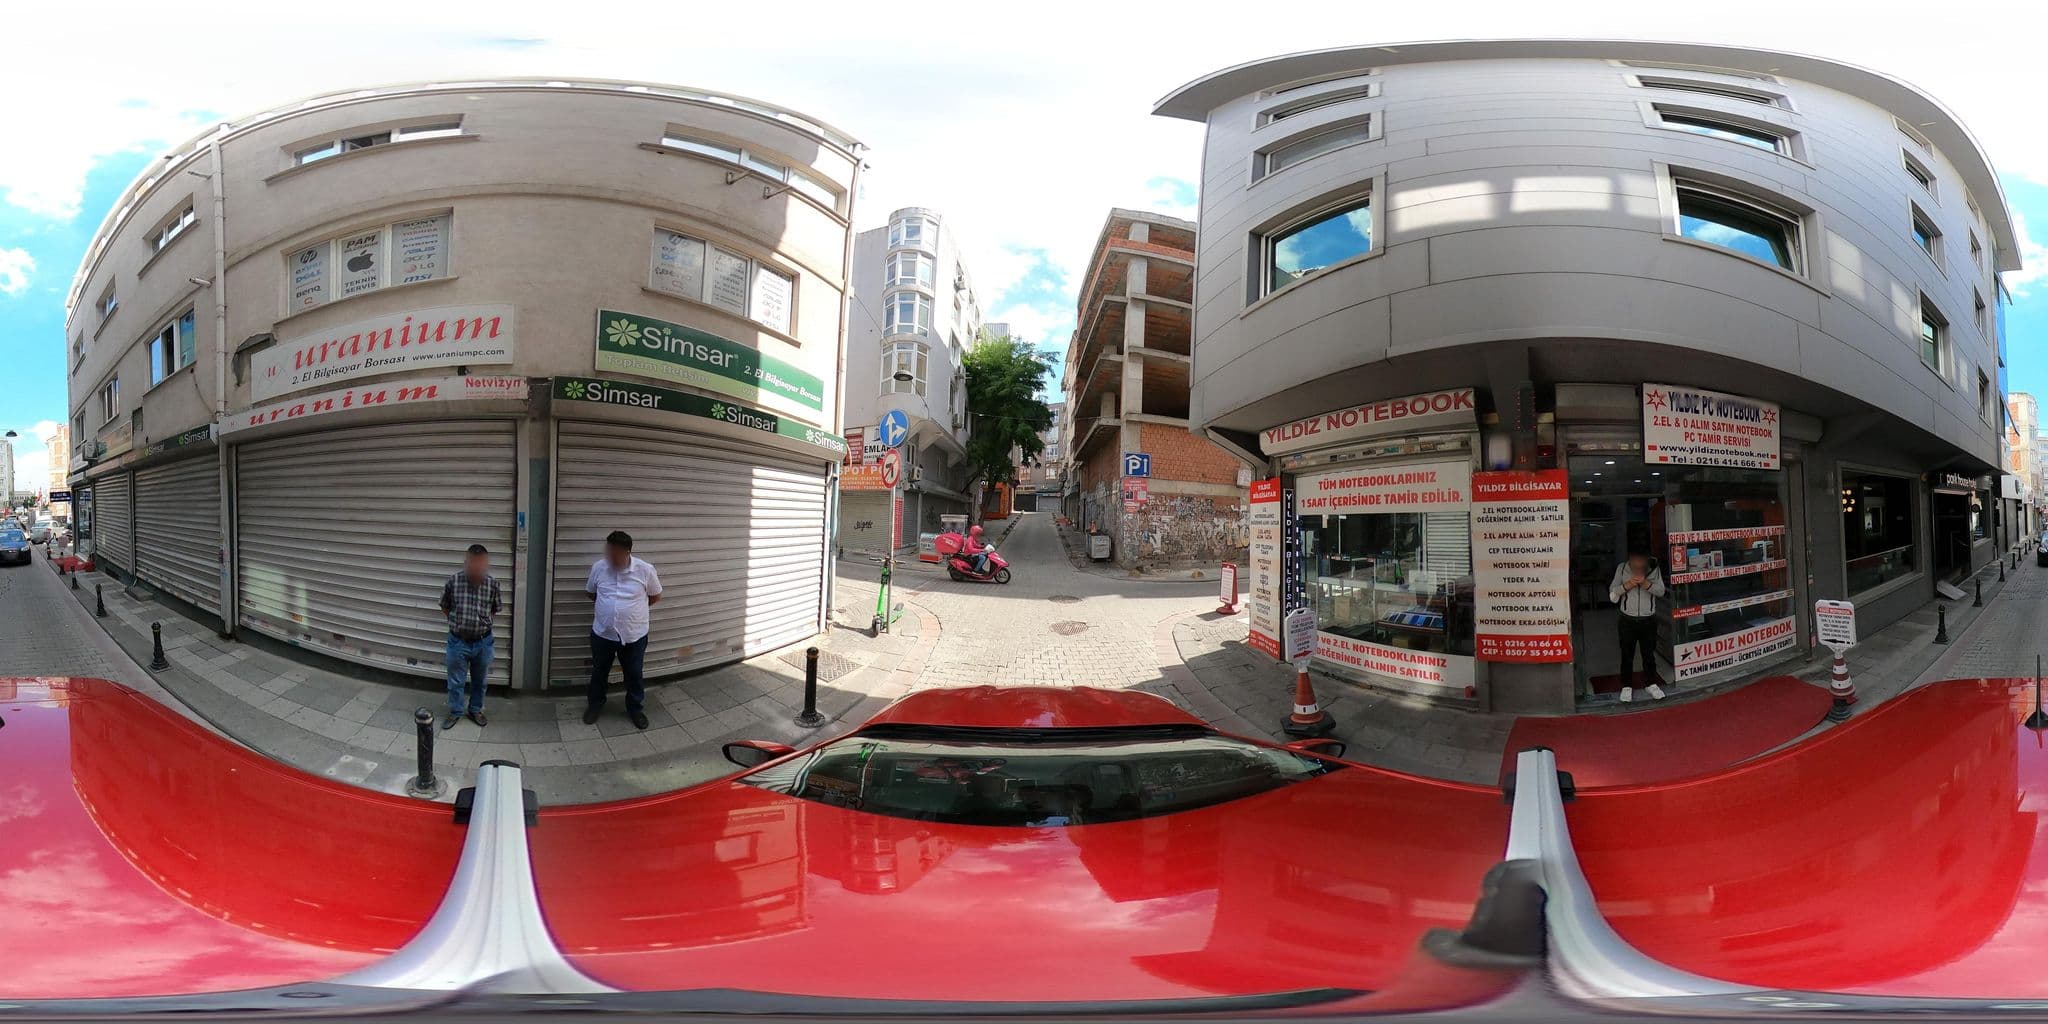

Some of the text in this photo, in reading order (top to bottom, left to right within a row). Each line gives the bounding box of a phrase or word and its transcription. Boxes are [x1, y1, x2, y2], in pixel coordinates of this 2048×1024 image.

[346, 234, 377, 248] PAM
[294, 316, 503, 371] uranium
[641, 326, 735, 368] Simsar
[292, 348, 505, 384] 2. El Bilgisayar Borsası www.uraniumpc.com
[744, 365, 752, 375] 2.
[754, 368, 764, 378] El
[249, 384, 438, 425] uranium
[586, 382, 662, 409] Simsar
[1668, 391, 1761, 423] YILDIZ PC NOTEBOOK
[726, 405, 777, 432] Simsar
[1266, 390, 1474, 444] YILDIZ NOTEBOOK
[1653, 415, 1672, 427] 2.EL
[1674, 418, 1681, 428] &
[1690, 419, 1710, 430] ALIM
[1712, 421, 1735, 432] SATIM
[1736, 424, 1773, 438] NOTEBOOK
[184, 428, 209, 444] Simsar
[814, 431, 844, 452] Simsar
[1684, 432, 1696, 442] PC
[1698, 432, 1721, 444] TAMİR
[1659, 445, 1770, 459] www.yildiznotebook.net
[1696, 457, 1720, 465] 0216
[1722, 458, 1738, 466] 414
[1740, 459, 1756, 467] 666
[1318, 471, 1437, 491] TÜM NOTEBOOKLARINIZ
[1478, 480, 1562, 493] YILDIZ BİLGİSAYAR
[1301, 487, 1464, 510] 1 SAAT İÇERİSİNDE TAMİR EDİLİR.
[1497, 505, 1558, 514] NOTEBOOKLARINIZ
[1695, 638, 1734, 658] YILDIZ
[1738, 620, 1792, 647] NOTEBOOK
[1316, 647, 1444, 682] DEĞERİNDE ALINIR SATILIR.
[1321, 637, 1332, 645] ve
[1333, 639, 1350, 650] 2.EL
[1352, 643, 1447, 668] NOTEBOOKLARINIZ
[1680, 668, 1688, 677] PC
[1690, 664, 1708, 676] TAMİR
[1709, 655, 1734, 670] MERKEZİ
[1738, 646, 1762, 662] ÜCRETSİZ
